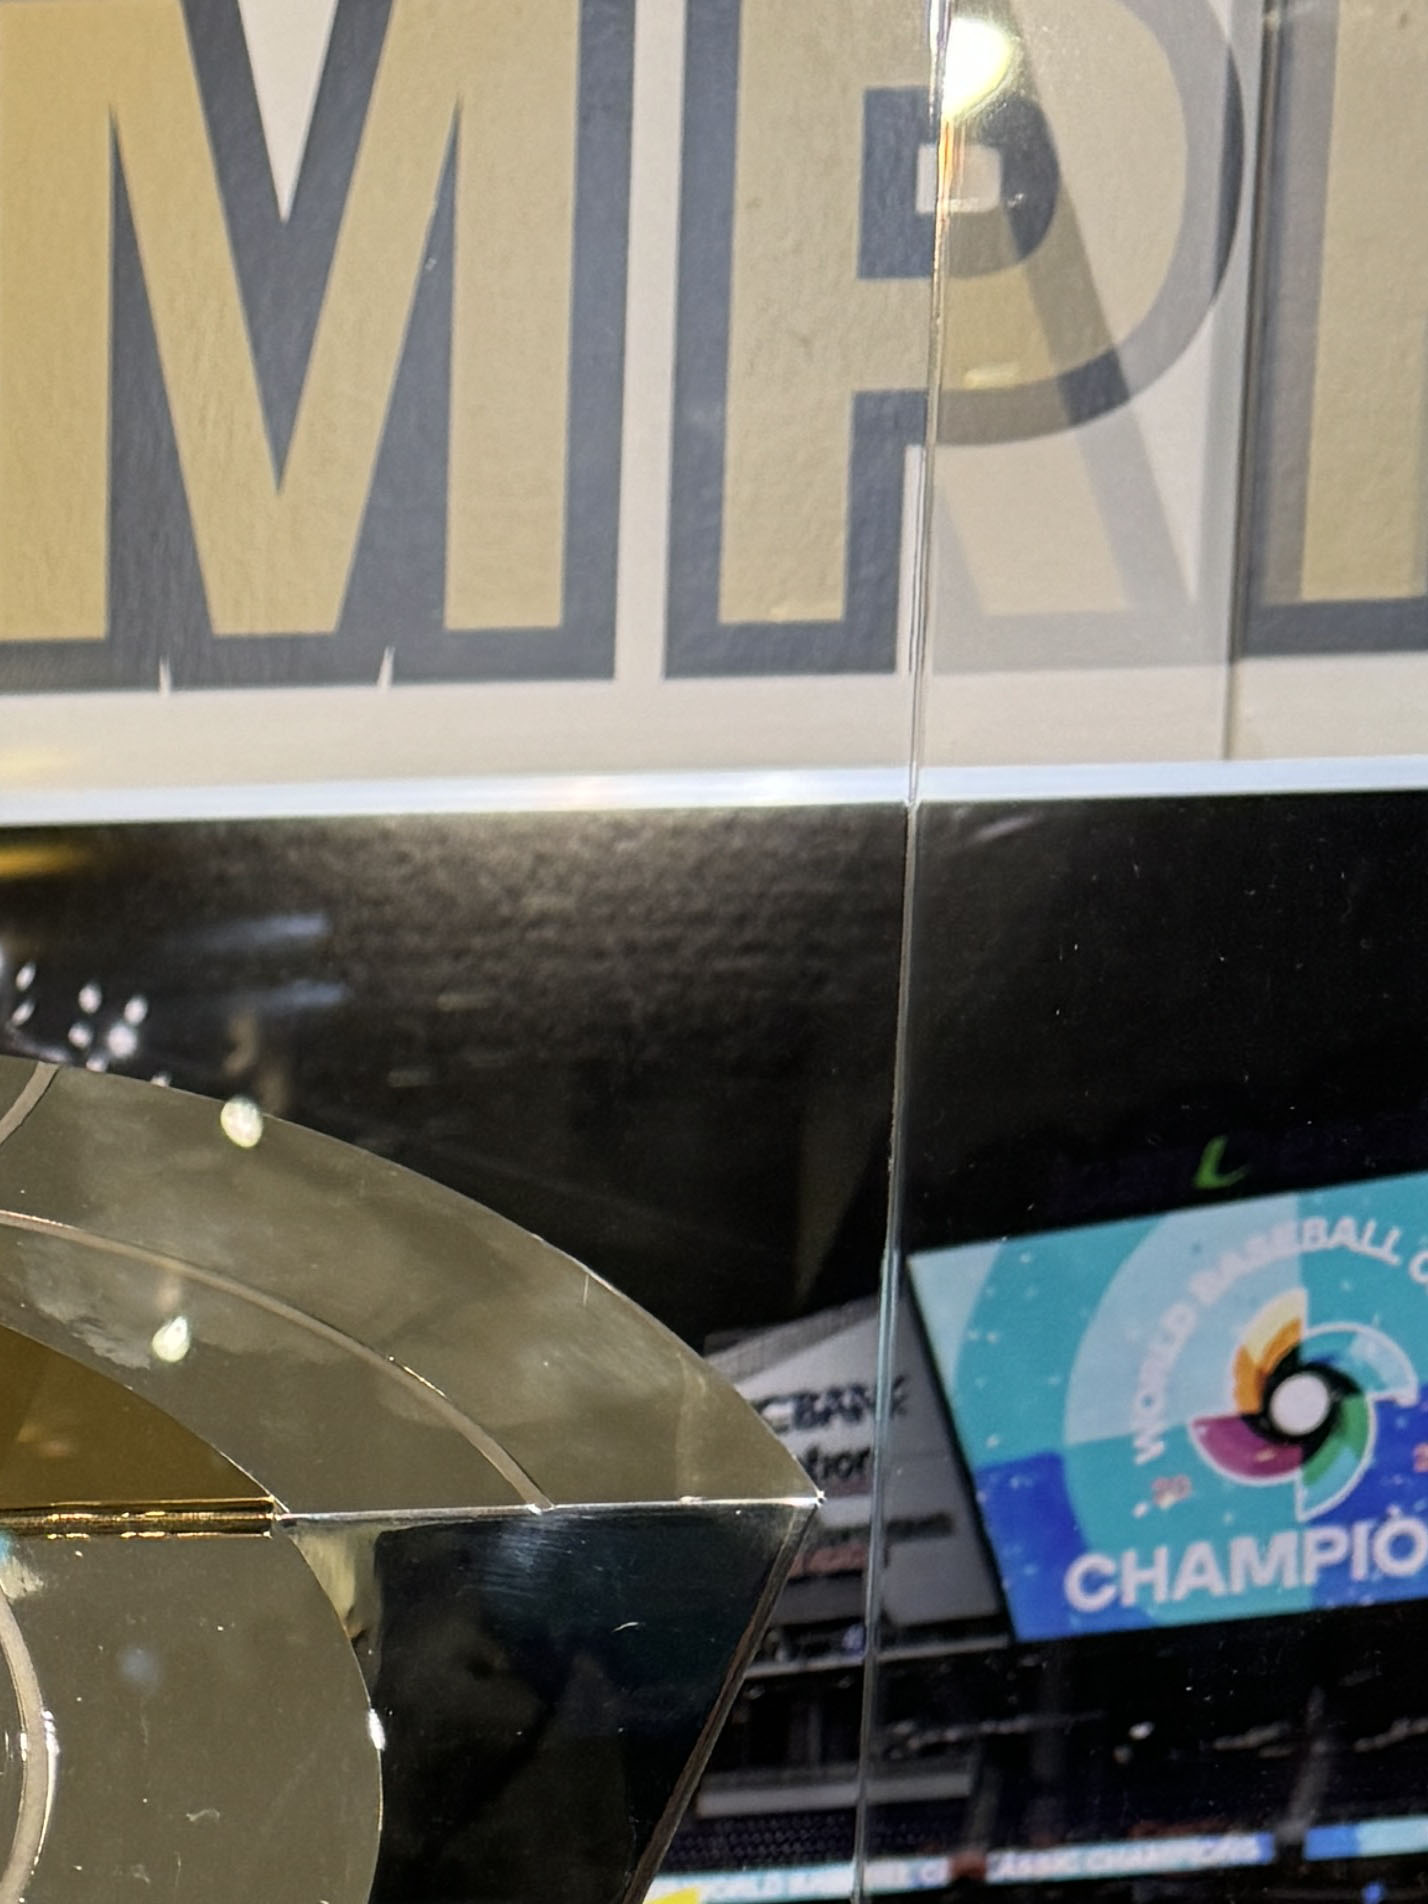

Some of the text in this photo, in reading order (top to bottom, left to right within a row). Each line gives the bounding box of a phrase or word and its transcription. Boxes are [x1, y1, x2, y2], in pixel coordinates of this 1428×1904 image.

[1131, 1302, 1196, 1466] WORLD
[1187, 1214, 1404, 1308] BASEBALL
[1063, 1516, 1428, 1613] CHAMPIO
